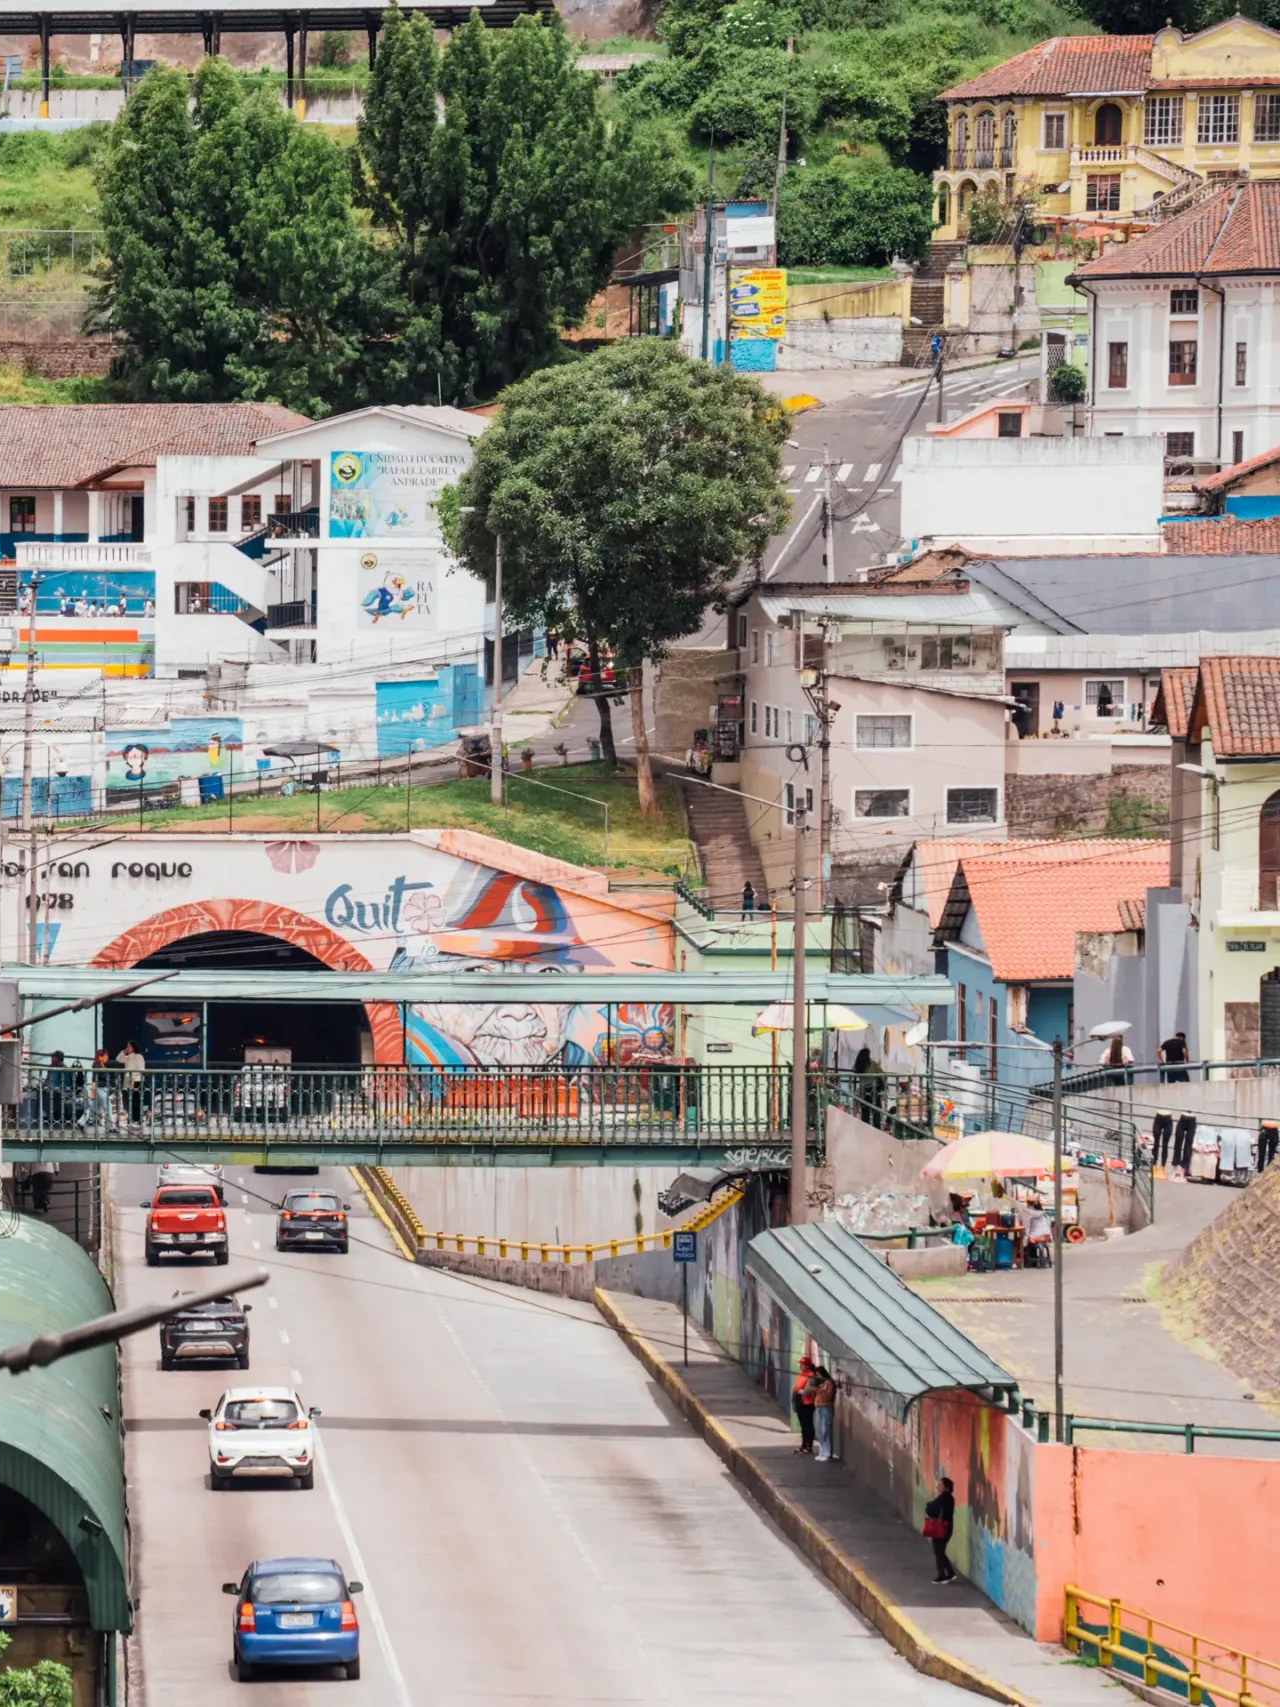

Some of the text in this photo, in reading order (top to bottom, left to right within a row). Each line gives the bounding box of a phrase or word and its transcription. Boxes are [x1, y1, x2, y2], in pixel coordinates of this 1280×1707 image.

[369, 454, 466, 464] UNIDAD EDUCATIVA
[419, 466, 457, 475] LARREA
[417, 581, 433, 592] RA
[417, 593, 427, 603] FI
[417, 604, 431, 615] TA
[111, 861, 194, 881] roque
